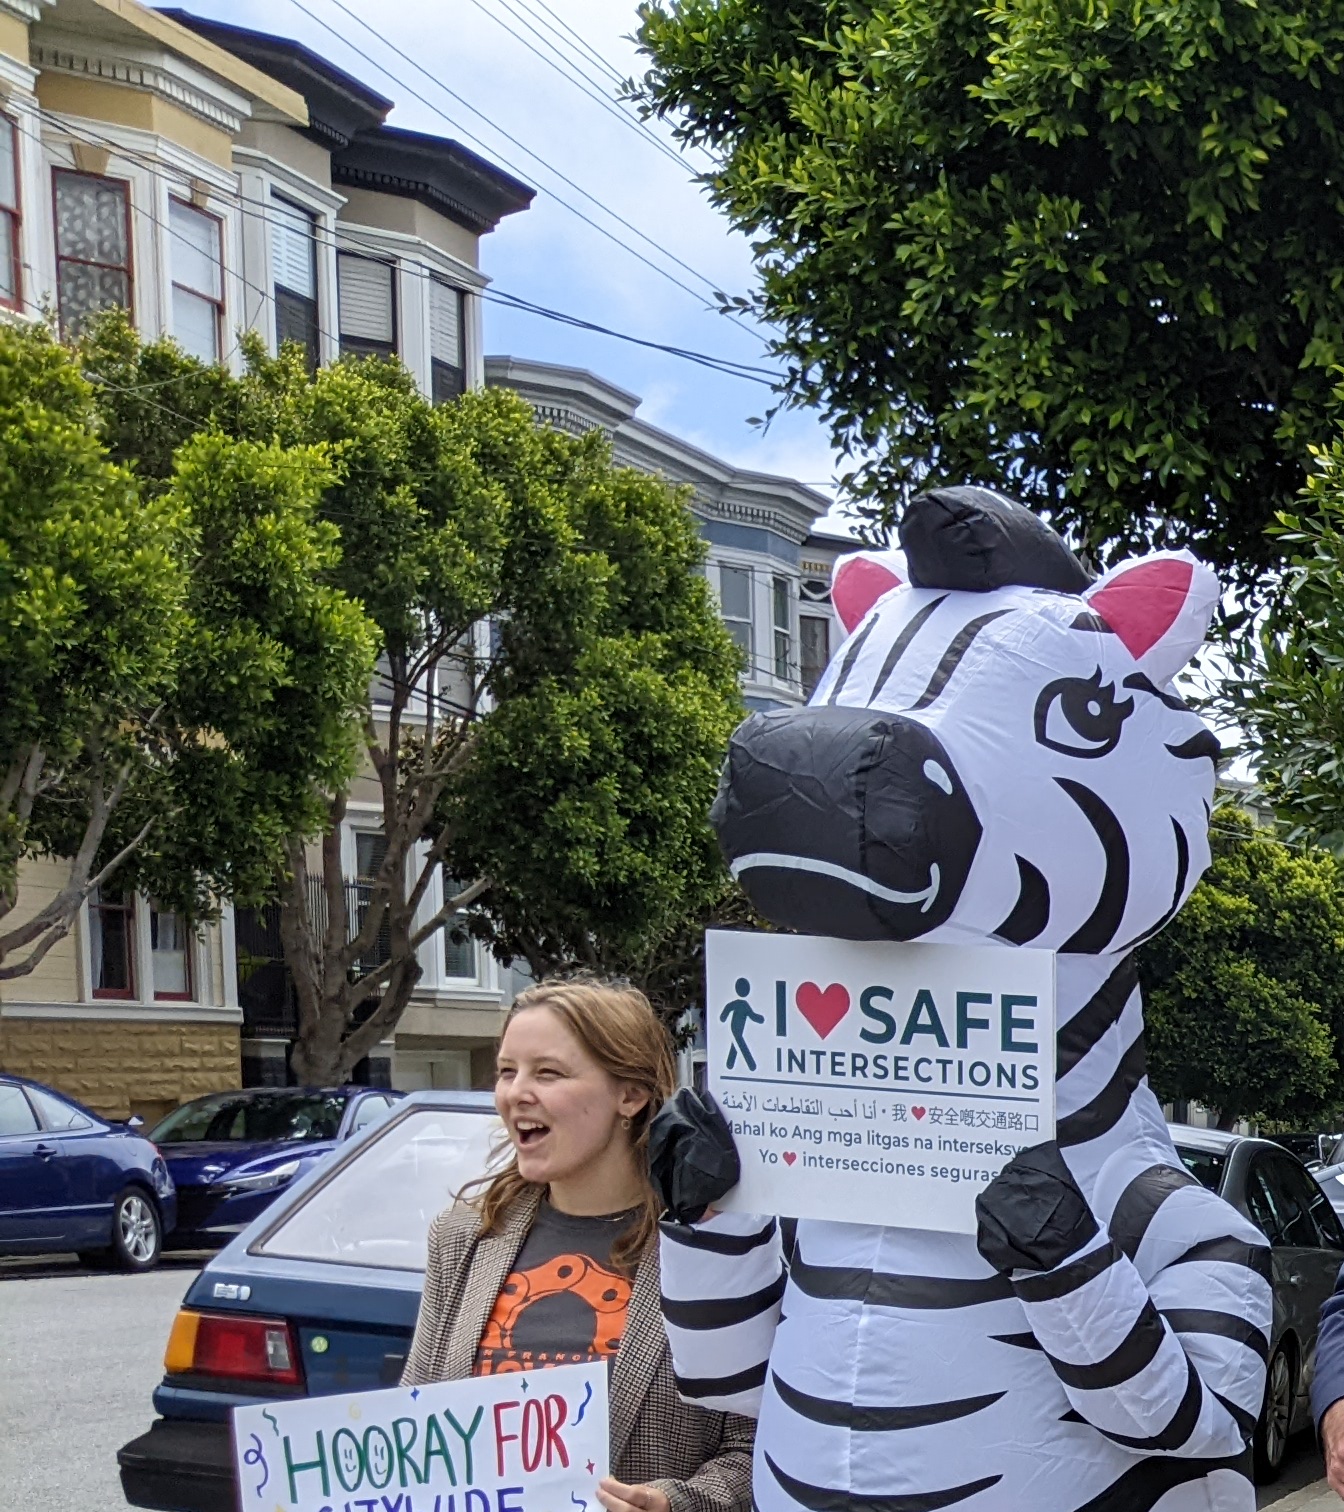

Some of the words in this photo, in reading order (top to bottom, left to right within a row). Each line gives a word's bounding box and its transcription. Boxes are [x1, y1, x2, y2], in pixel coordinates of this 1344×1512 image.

[775, 980, 787, 1037] I
[858, 985, 1039, 1054] SAFE
[776, 1047, 1040, 1091] INTERSECTIONS
[769, 1124, 788, 1139] ko
[791, 1125, 823, 1145] Ang
[827, 1131, 862, 1147] mga
[867, 1130, 910, 1150] litgas
[914, 1136, 934, 1151] na
[891, 1103, 908, 1123] 我
[928, 1105, 1040, 1133] 安全嘅交通路口
[758, 1148, 778, 1164] Yo
[802, 1151, 925, 1177] intersecciones
[930, 1165, 1000, 1183] seguras
[283, 1404, 485, 1504] HOORAY
[493, 1393, 571, 1478] FOR
